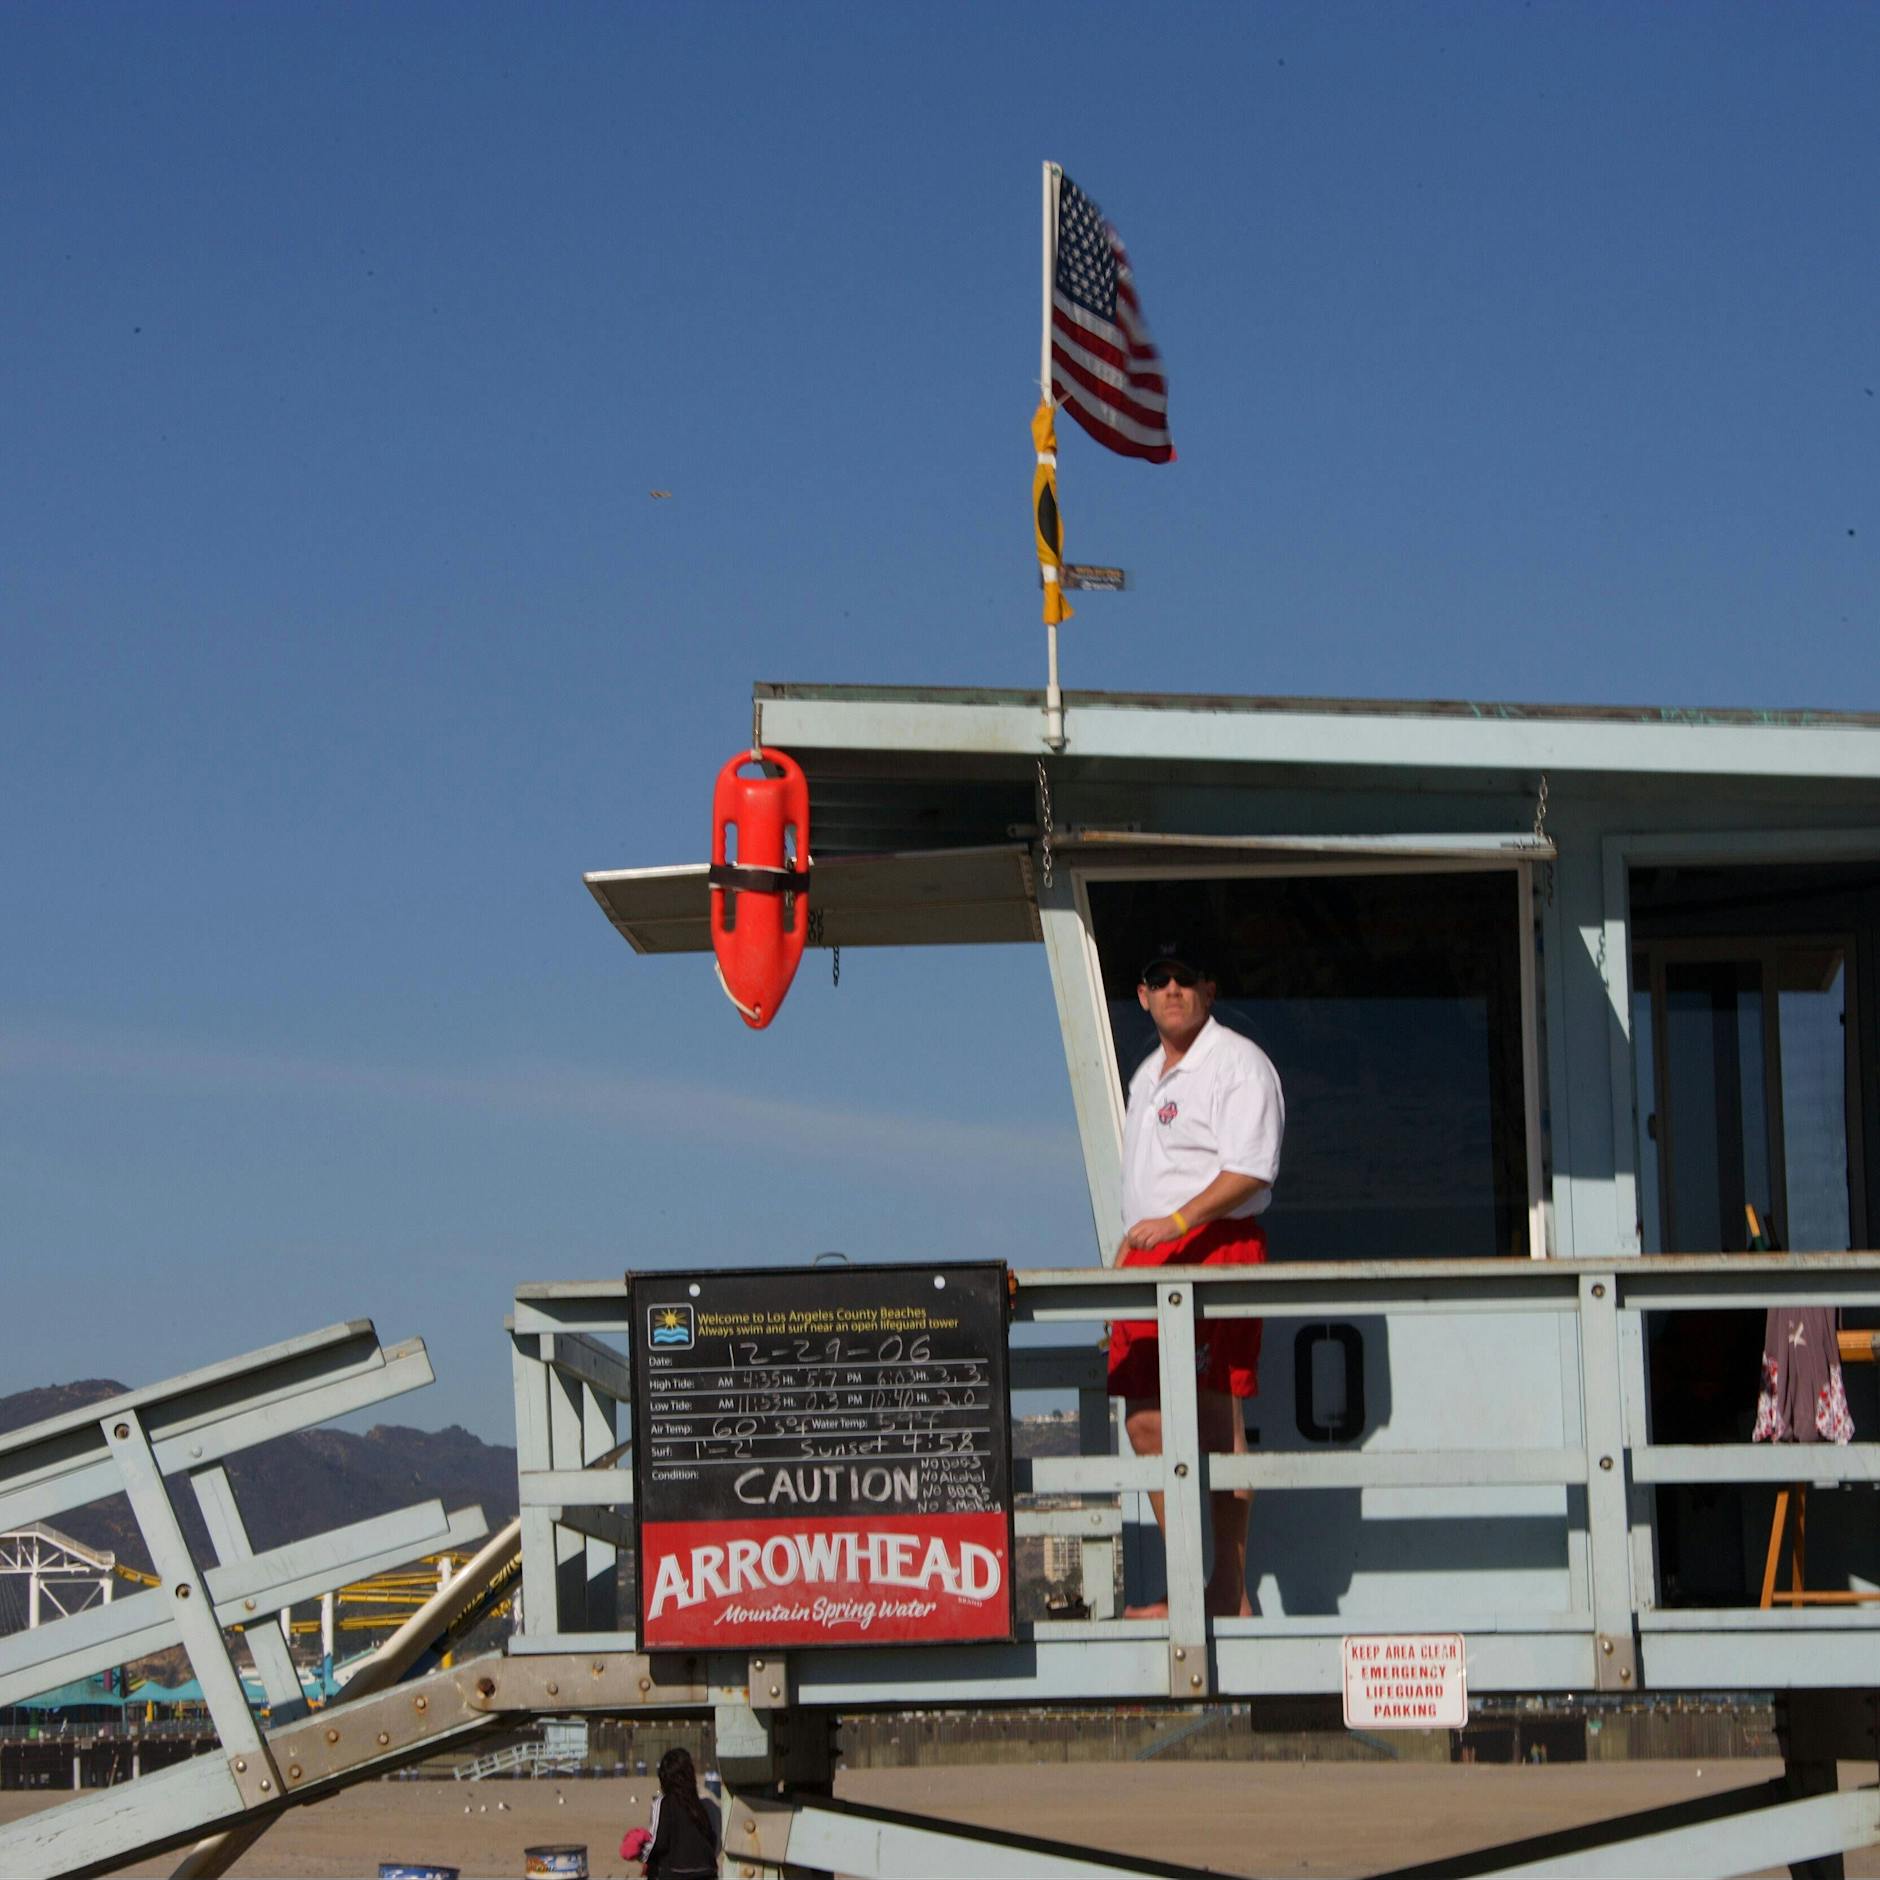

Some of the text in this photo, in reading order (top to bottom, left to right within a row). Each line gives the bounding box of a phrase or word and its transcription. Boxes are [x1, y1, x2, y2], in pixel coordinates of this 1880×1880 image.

[697, 1306, 927, 1325] Welcome to Los Angeles County Beaches
[697, 1318, 958, 1338] Always swim and surf near an open lifeguard tower
[648, 1356, 673, 1367] Date:
[650, 1379, 671, 1392] High
[672, 1379, 695, 1390] Tide:
[717, 1376, 734, 1388] AM
[847, 1371, 862, 1384] PM
[650, 1401, 670, 1411] Low
[671, 1400, 693, 1411] Tide:
[718, 1398, 734, 1409] AM
[847, 1393, 863, 1406] PM
[650, 1424, 664, 1434] Air
[667, 1423, 693, 1436] Temp:
[811, 1418, 839, 1430] Water
[840, 1417, 868, 1430] Temp:
[651, 1446, 673, 1457] Surf:
[799, 1433, 888, 1459] Sunset
[902, 1430, 975, 1455] 4:58
[651, 1465, 918, 1504] Condition: CAUTION
[647, 1532, 1001, 1622] ARROWHEAD
[713, 1602, 811, 1626] Mountain
[813, 1595, 877, 1630] Spring
[1351, 1644, 1457, 1660] KEEP AREA CLEAR
[1361, 1665, 1446, 1679] EMERGENCY
[1365, 1685, 1444, 1699] LIFEGUARD
[1374, 1703, 1437, 1718] PARKING
